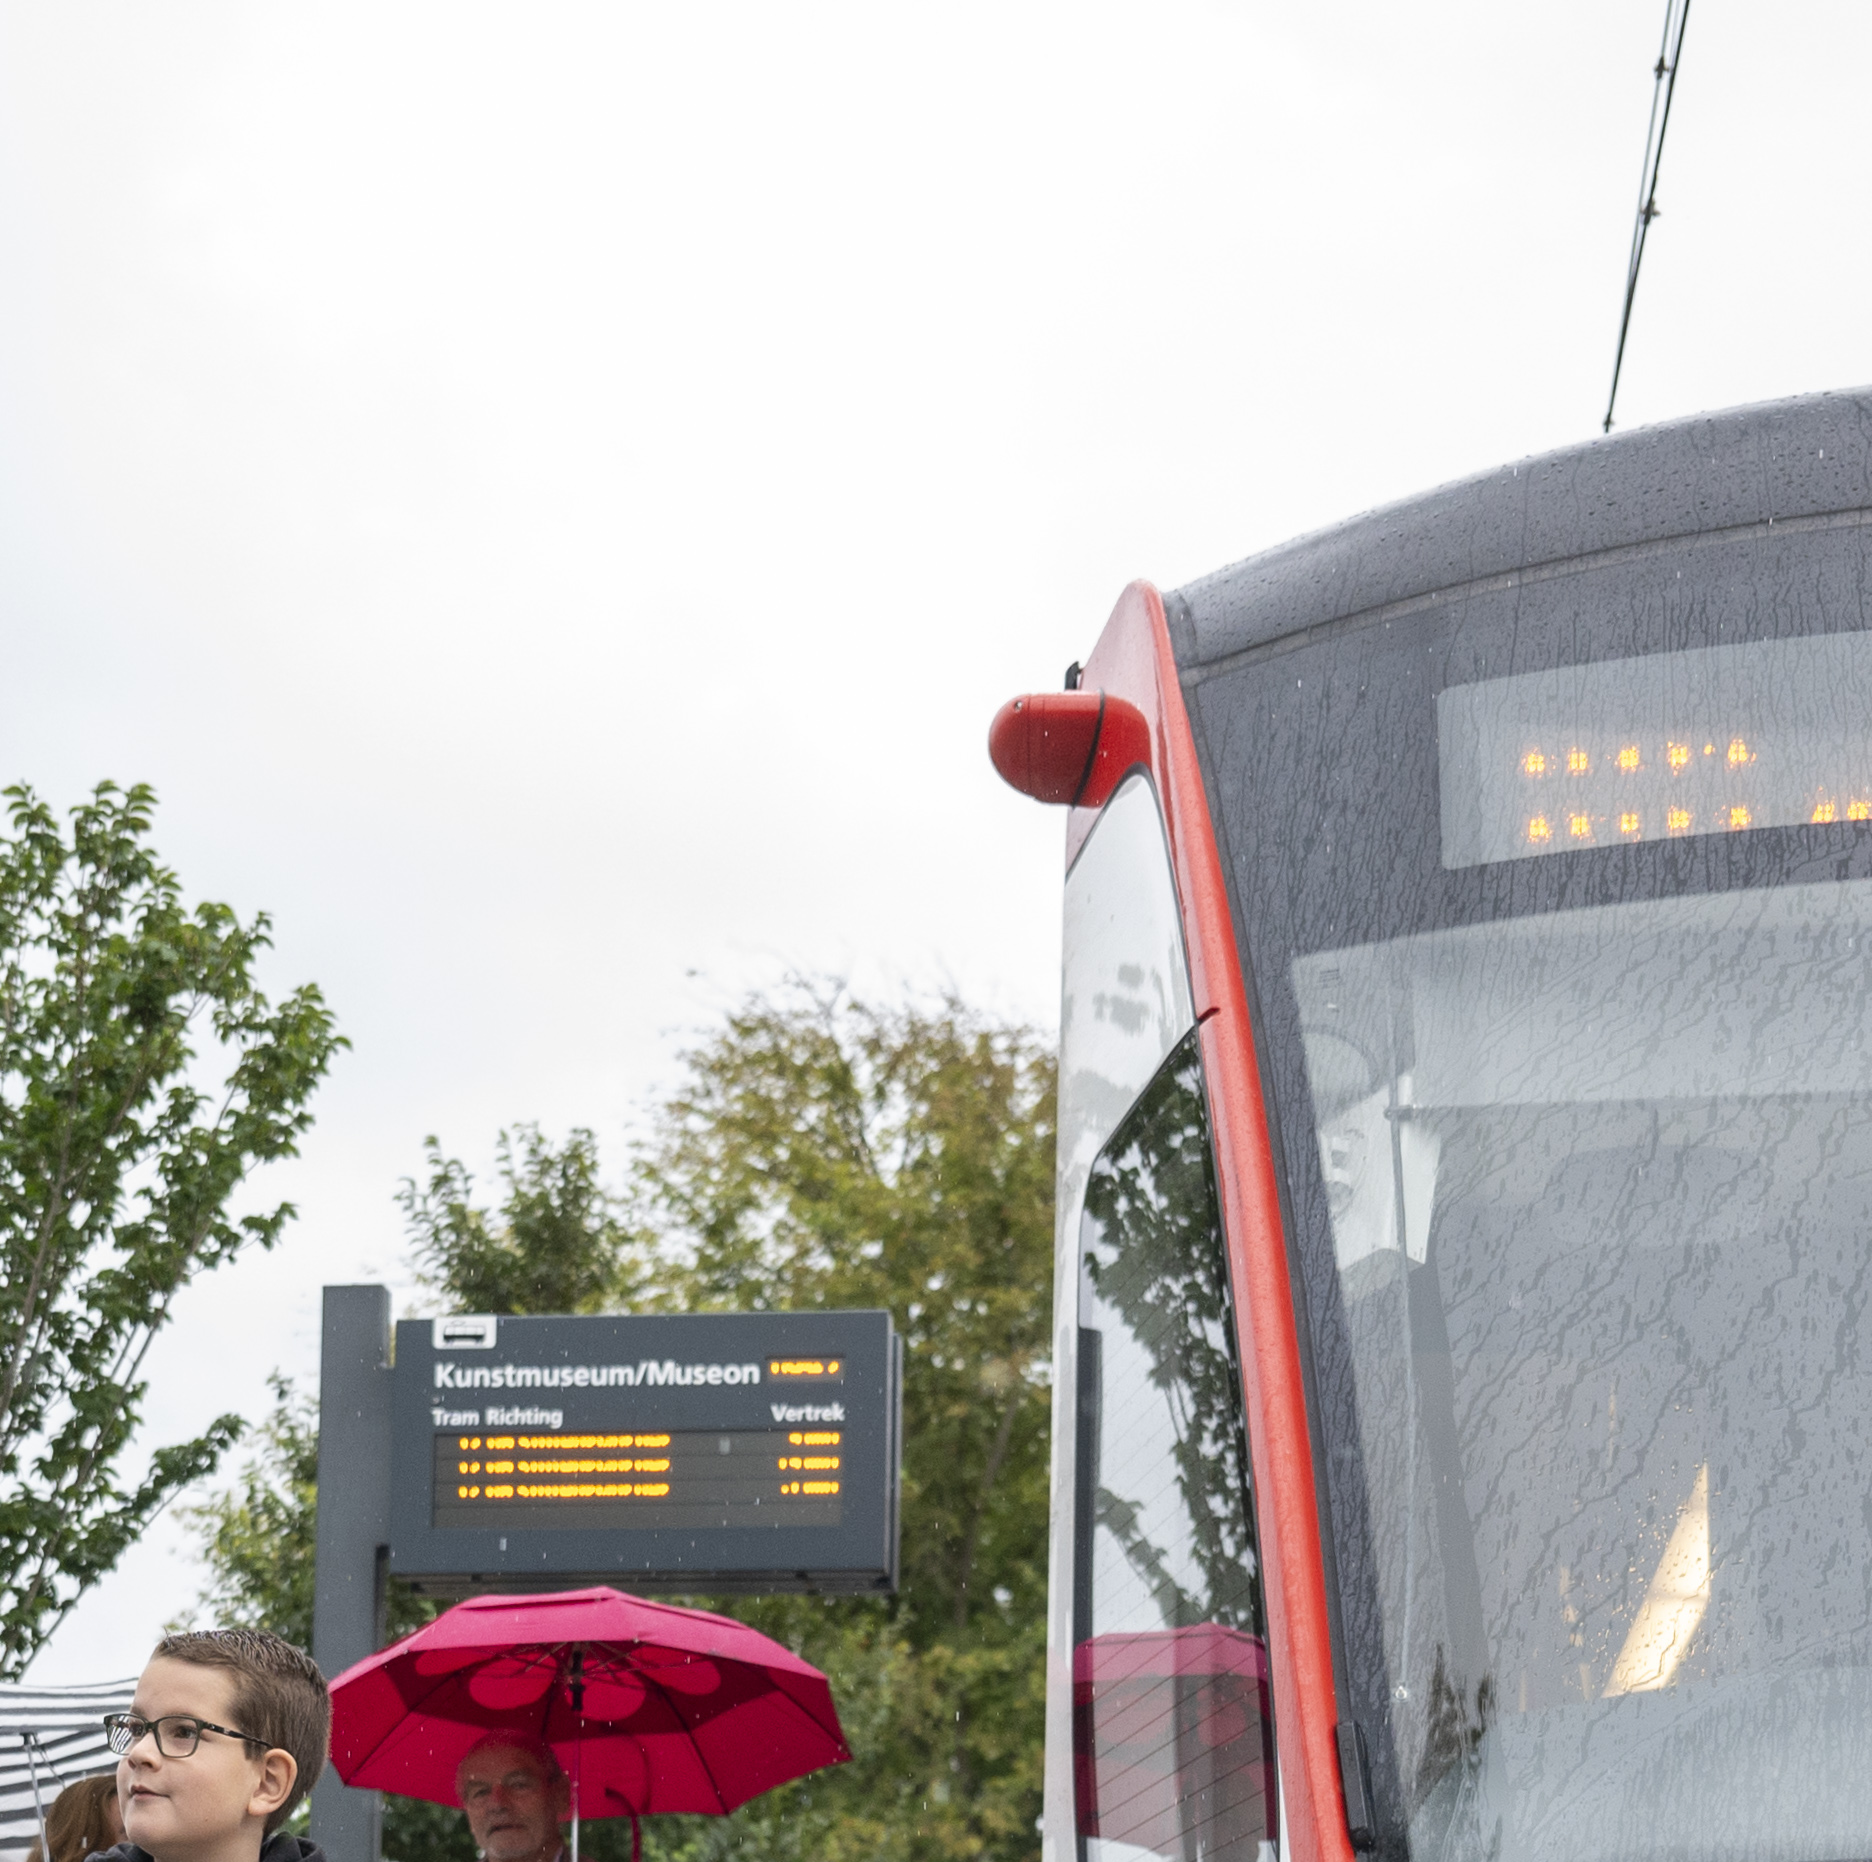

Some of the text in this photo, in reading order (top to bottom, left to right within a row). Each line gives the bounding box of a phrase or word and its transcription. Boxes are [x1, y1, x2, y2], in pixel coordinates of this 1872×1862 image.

[433, 1360, 761, 1390] Kunstmuseum/Museon
[432, 1402, 847, 1430] Tram Richting Vertrek
